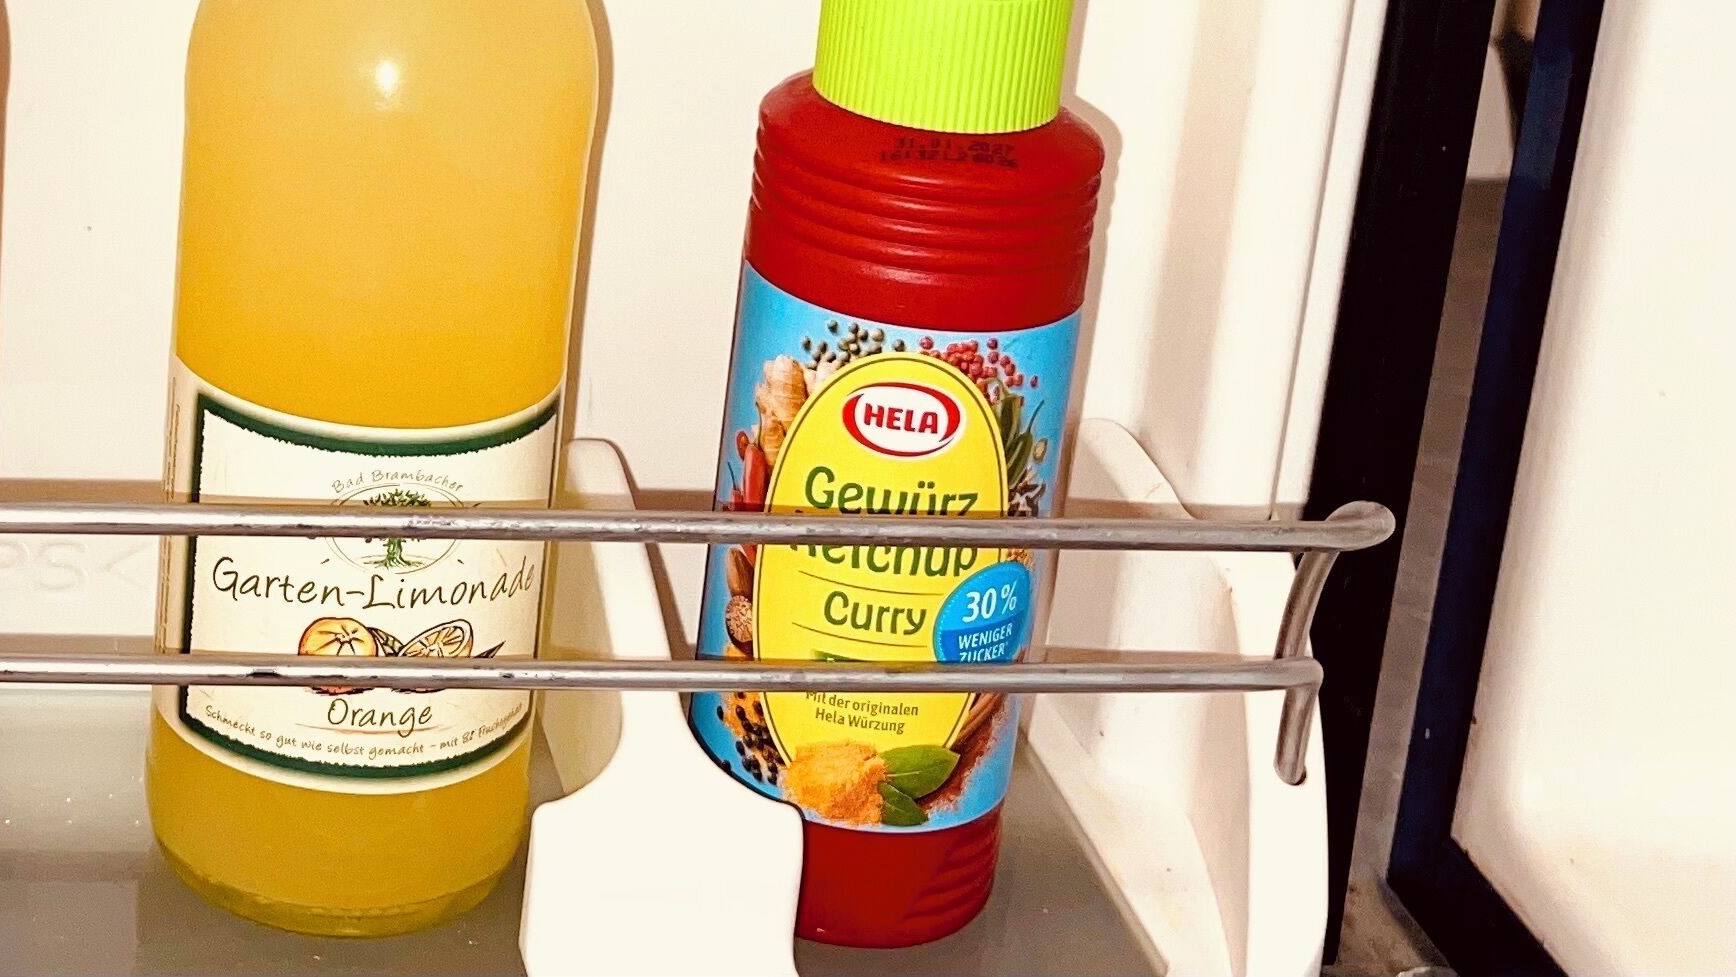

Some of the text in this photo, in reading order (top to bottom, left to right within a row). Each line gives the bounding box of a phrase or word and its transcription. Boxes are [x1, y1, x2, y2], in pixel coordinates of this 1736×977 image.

[862, 402, 942, 435] HELA
[331, 469, 464, 494] Bad Brambacher
[804, 465, 979, 517] Gewürz
[211, 555, 537, 611] Garten-Limonade
[823, 590, 928, 636] Curry
[957, 622, 1013, 650] WENIGER
[326, 697, 434, 739] Orange
[805, 690, 920, 717] Mit der originalen
[814, 706, 906, 735] Hela Würzung
[205, 704, 256, 737] Schmeckt
[259, 729, 273, 742] so
[276, 734, 297, 749] gut
[301, 740, 323, 752] wie
[368, 741, 425, 761] gemacht
